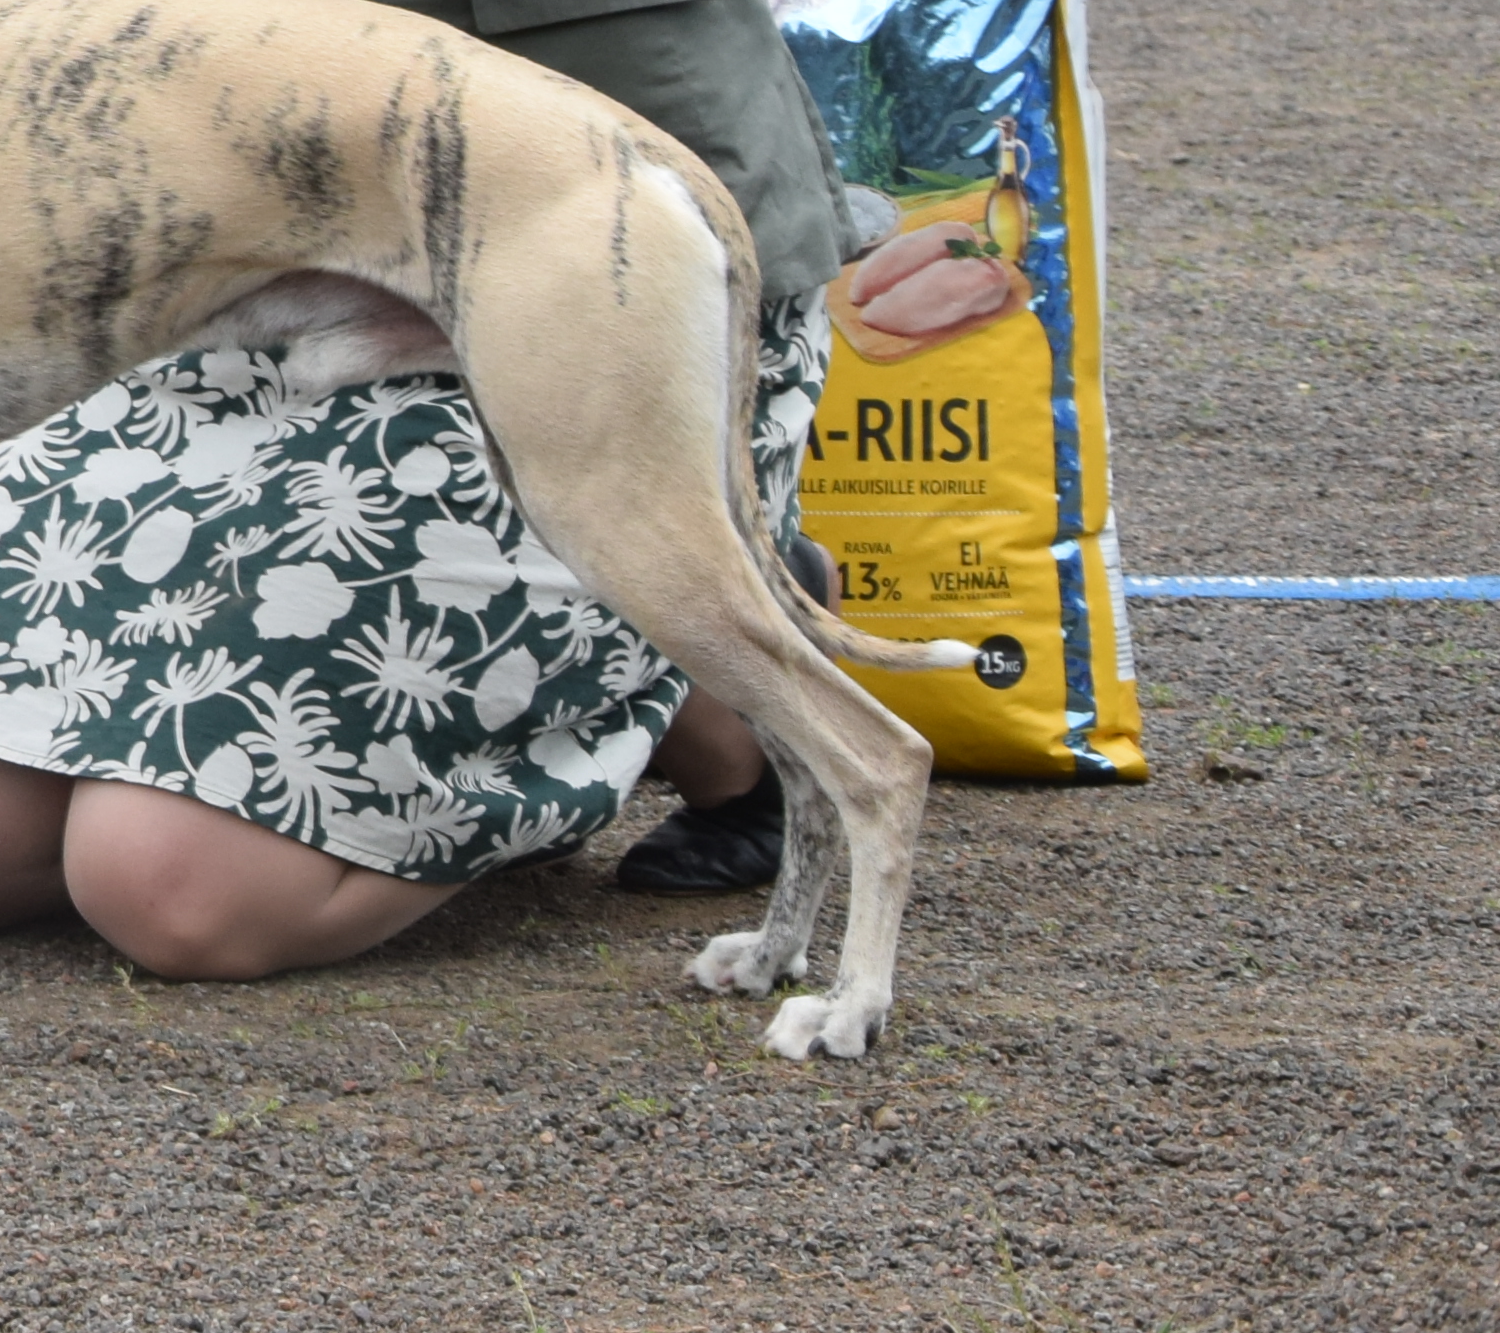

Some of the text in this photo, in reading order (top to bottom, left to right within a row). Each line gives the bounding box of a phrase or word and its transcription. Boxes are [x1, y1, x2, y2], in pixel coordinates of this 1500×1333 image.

[831, 479, 916, 496] AIKUISILLE
[920, 479, 988, 496] KOIRILLE
[844, 542, 893, 555] RASVAA
[960, 541, 983, 566] EI
[838, 561, 903, 602] 13%
[930, 566, 1011, 592] VEHNÄÄ
[979, 651, 1022, 675] 15KG
